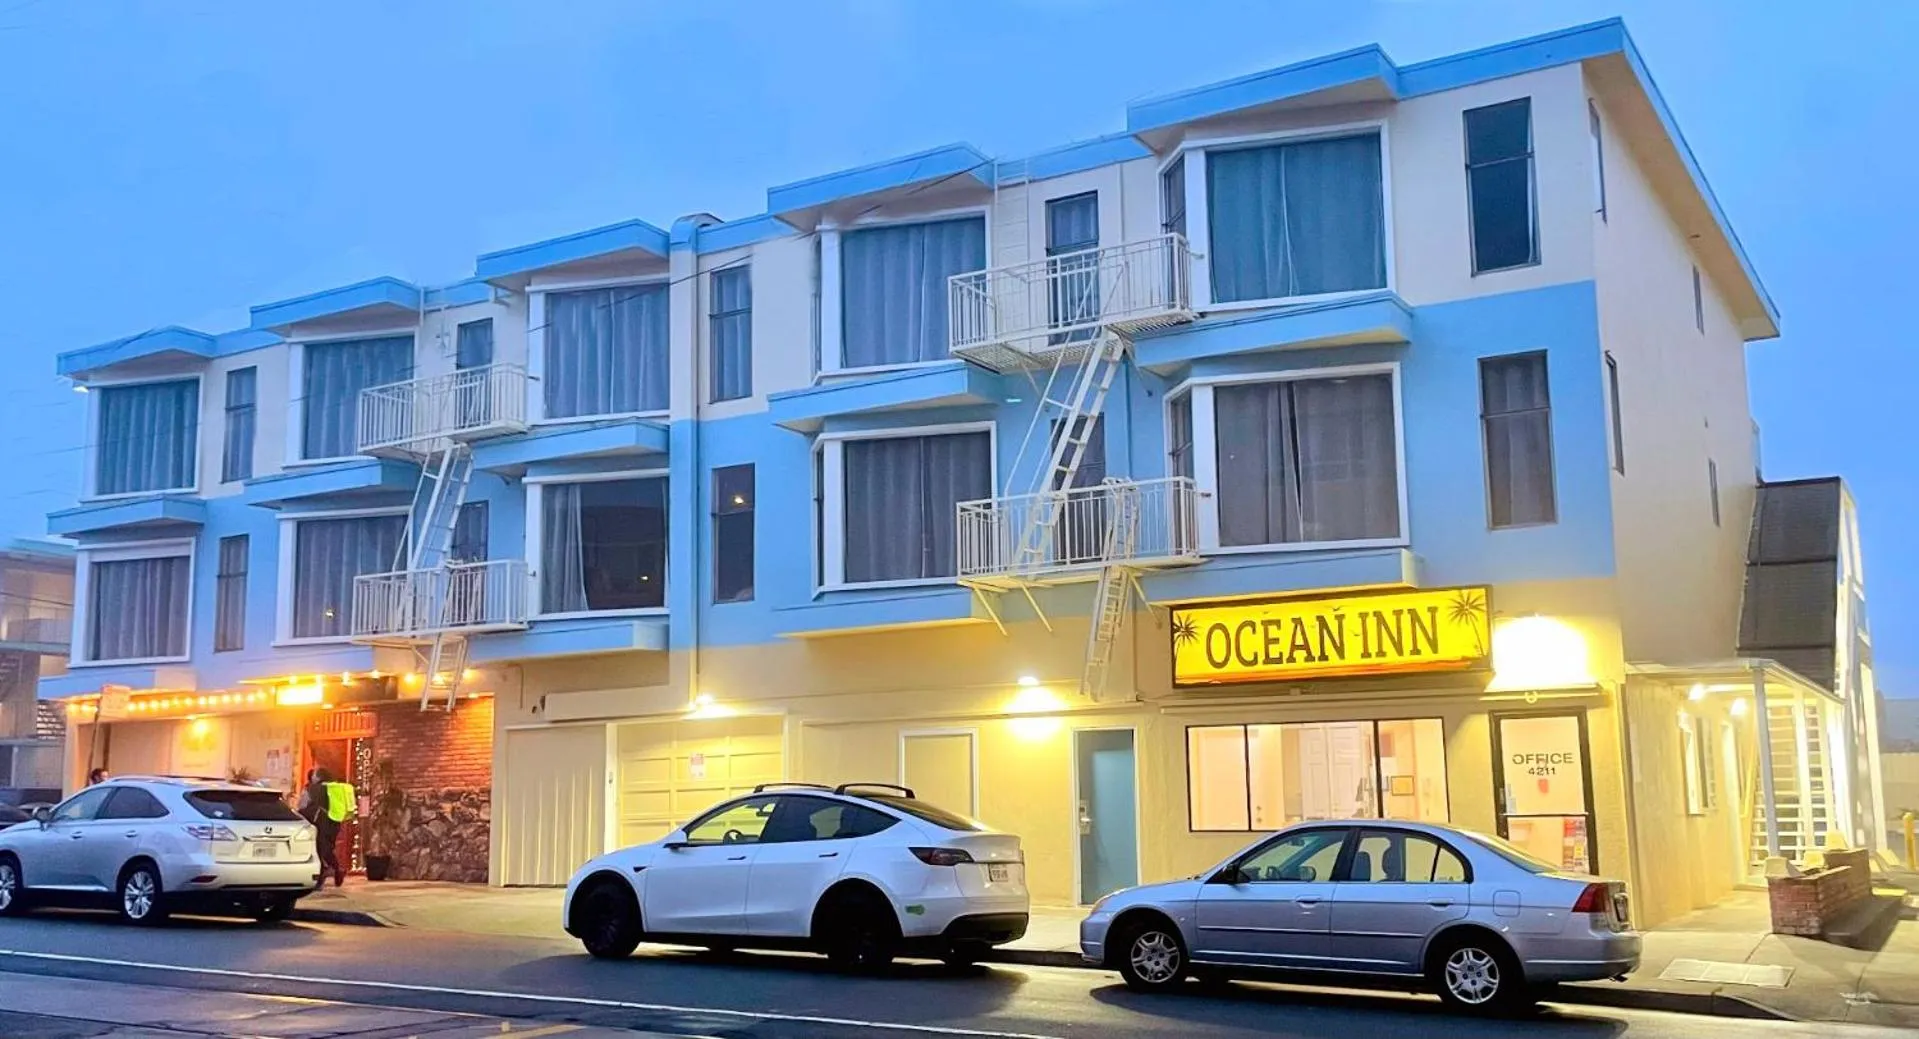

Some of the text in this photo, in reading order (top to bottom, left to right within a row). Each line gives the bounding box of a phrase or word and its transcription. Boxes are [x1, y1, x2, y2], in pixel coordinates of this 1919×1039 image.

[1205, 606, 1439, 669] OCEAN INN
[1512, 752, 1574, 765] OFFICE
[1528, 767, 1556, 776] 4211
